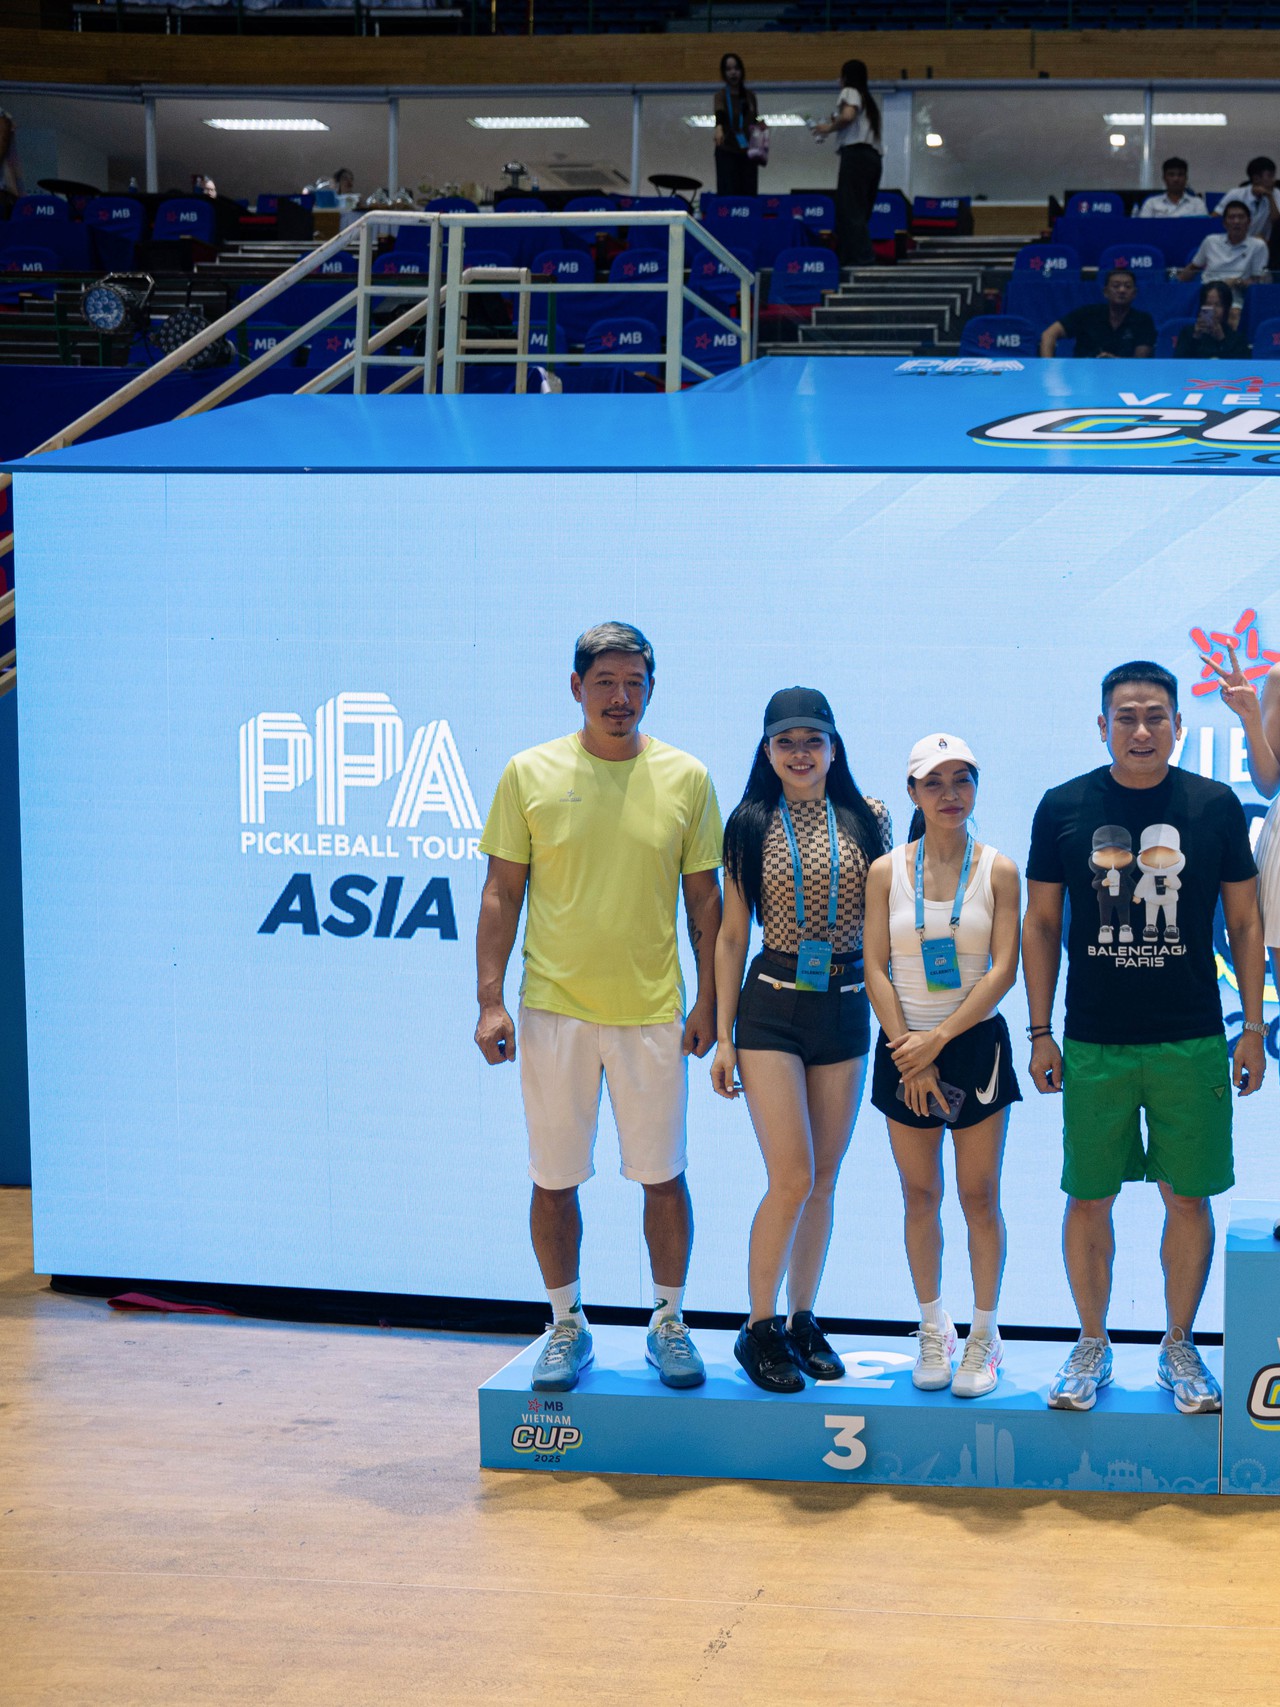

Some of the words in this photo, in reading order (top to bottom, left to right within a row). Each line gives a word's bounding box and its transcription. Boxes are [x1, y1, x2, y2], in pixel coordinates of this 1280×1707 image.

[873, 203, 891, 213] MB
[941, 199, 959, 209] MB
[1092, 202, 1112, 213] MB
[36, 206, 55, 215] MB
[112, 208, 131, 219] MB
[180, 211, 198, 222] MB
[731, 206, 750, 218] MB
[805, 206, 824, 217] MB
[322, 262, 343, 273] MB
[558, 262, 579, 273] MB
[638, 262, 659, 274] MB
[803, 261, 825, 273] MB
[1047, 258, 1068, 270] MB
[1130, 256, 1152, 268] MB
[254, 337, 278, 351] MB
[619, 332, 642, 345] MB
[713, 334, 738, 347] MB
[996, 334, 1021, 348] MB
[239, 692, 484, 829] PPA
[240, 831, 399, 858] PICKLEBALL
[407, 836, 486, 861] TOUR
[257, 873, 459, 941] ASIA
[1115, 957, 1165, 968] PARIS
[544, 1400, 563, 1411] MB
[522, 1414, 571, 1425] VIETNAM
[511, 1425, 583, 1454] CUP
[822, 1414, 867, 1470] 3
[534, 1454, 561, 1463] 2025
